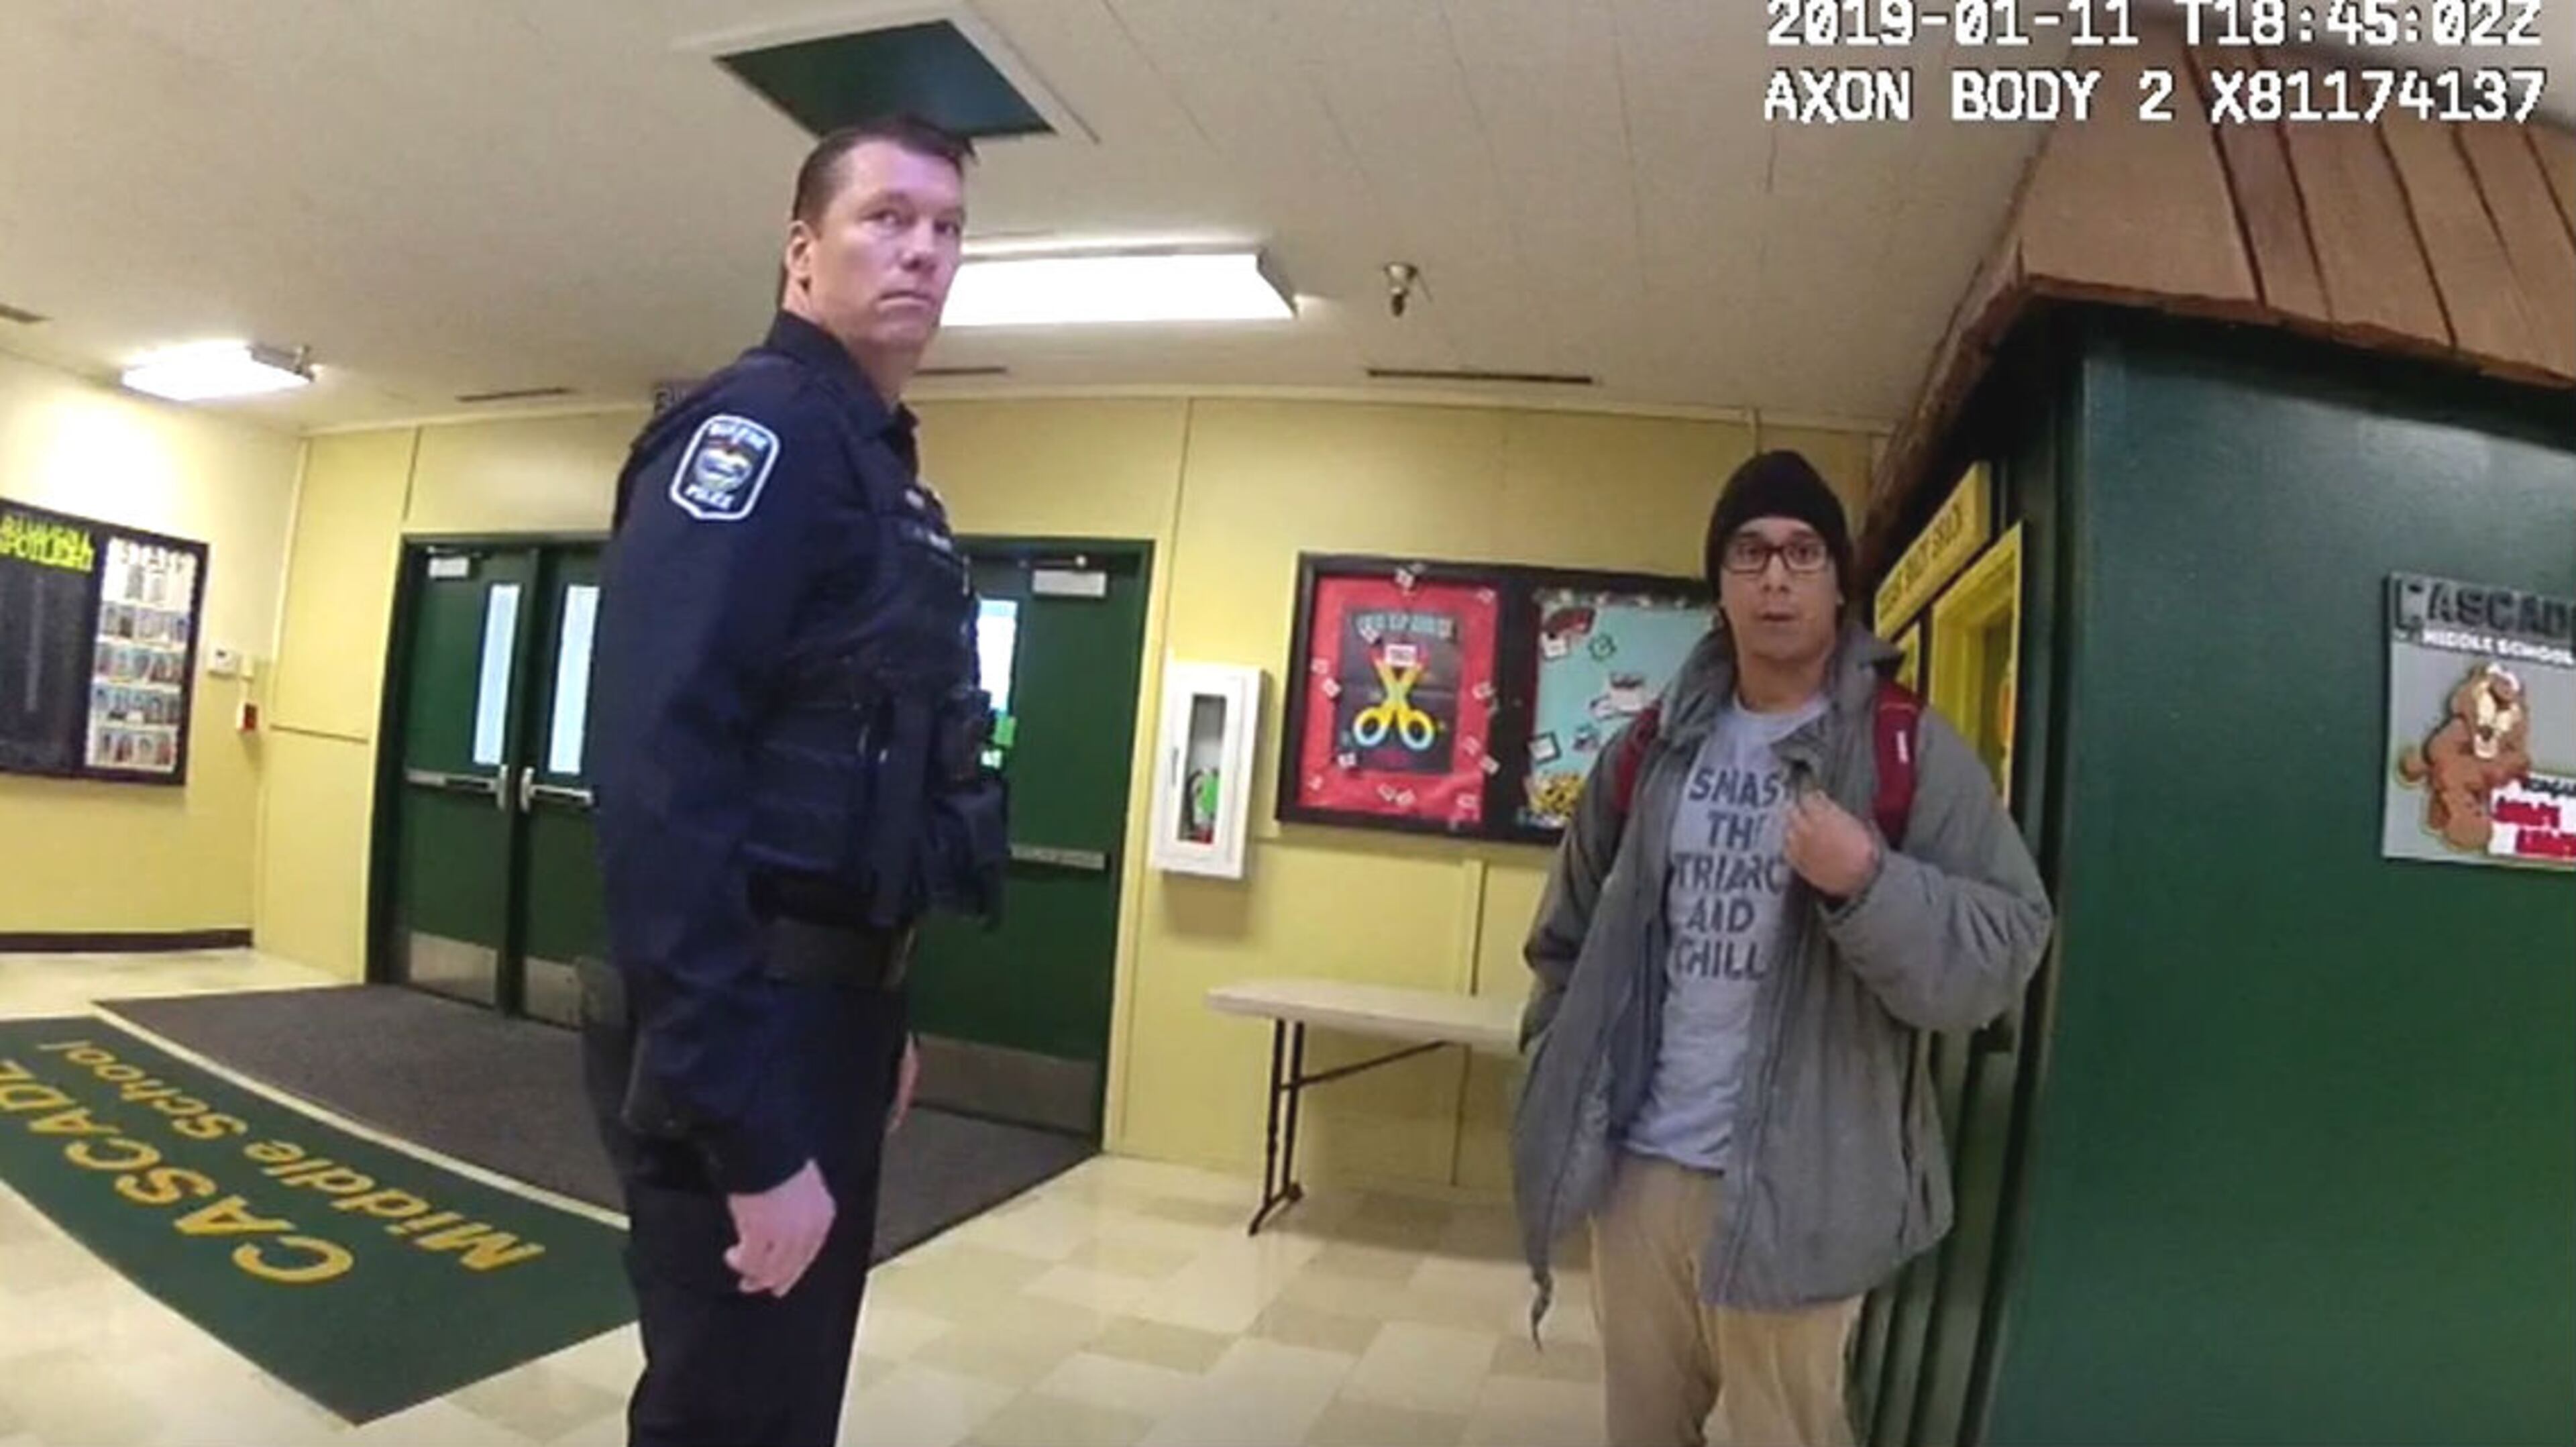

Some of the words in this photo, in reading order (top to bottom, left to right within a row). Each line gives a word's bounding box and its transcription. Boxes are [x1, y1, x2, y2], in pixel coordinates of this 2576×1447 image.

[2394, 578, 2576, 643] CASCAD
[2422, 629, 2493, 653] MIDDLE
[2496, 637, 2575, 665] SCHOOL
[1688, 766, 1790, 807] SMAS
[1677, 936, 1766, 982] CHILL
[36, 1040, 248, 1140] School
[244, 1139, 545, 1273] Middle
